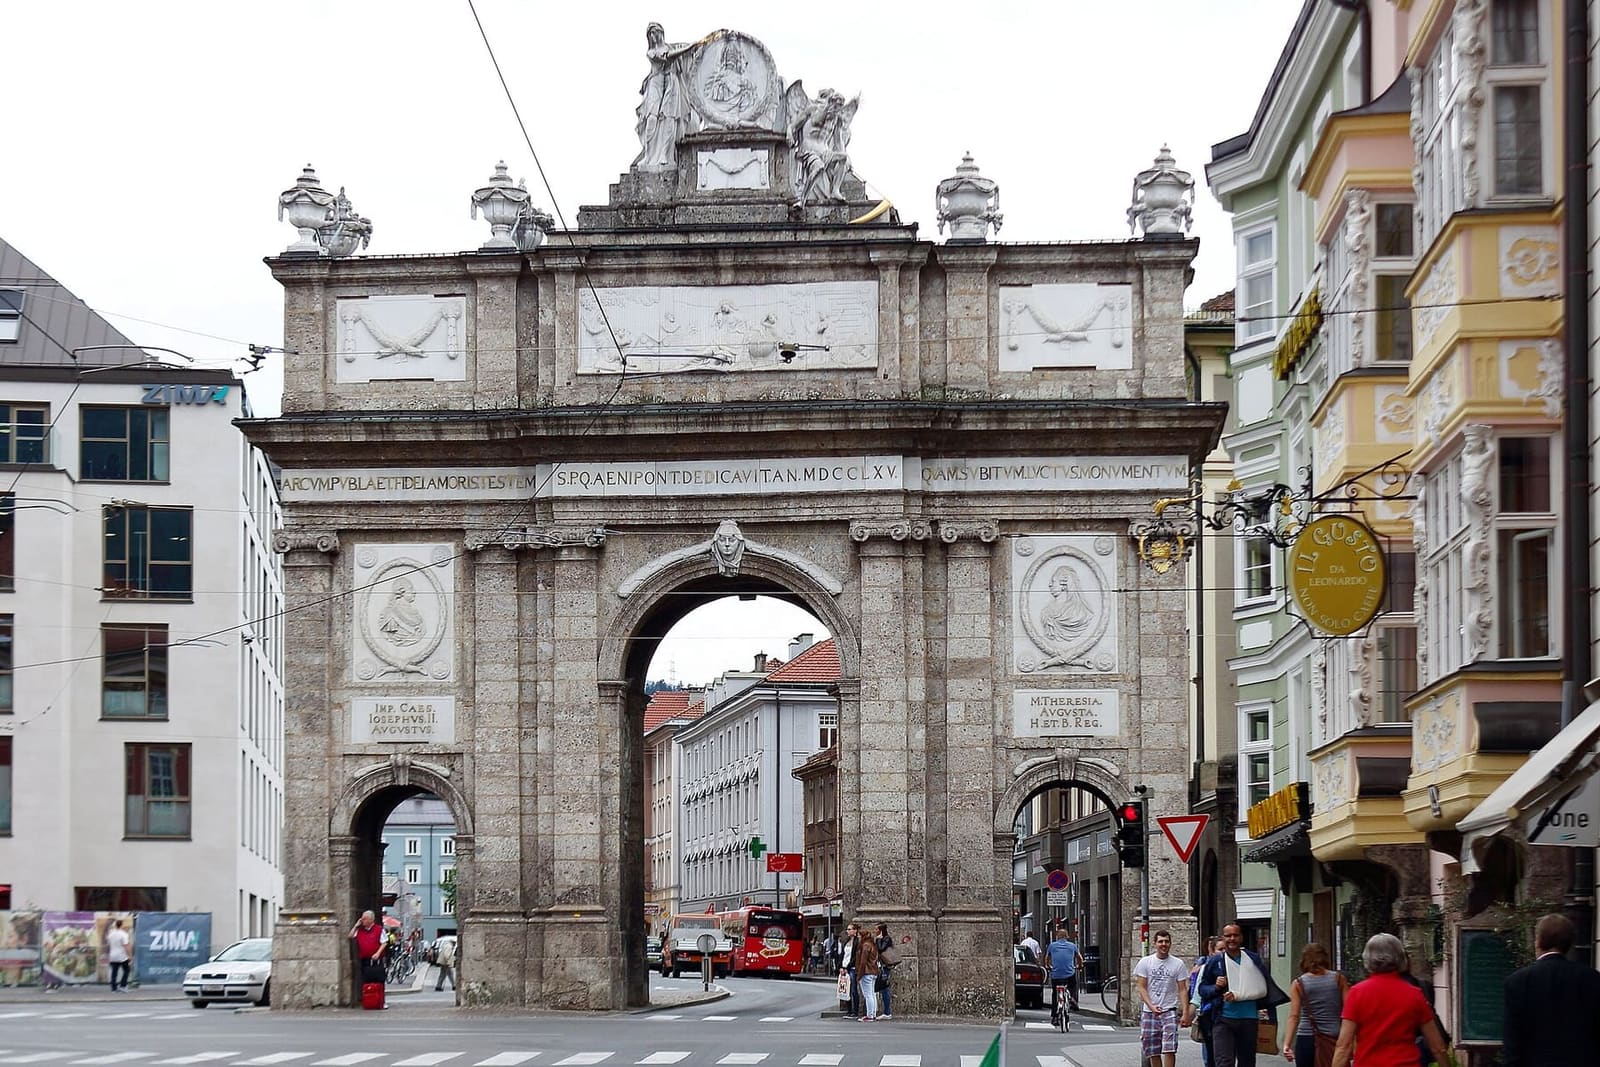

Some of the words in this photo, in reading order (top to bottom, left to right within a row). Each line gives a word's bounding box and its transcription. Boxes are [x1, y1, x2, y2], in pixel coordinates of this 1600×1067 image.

[142, 384, 229, 405] ZIMA
[1312, 522, 1377, 572] GUSTO
[1329, 565, 1345, 574] DA
[1308, 576, 1369, 587] LEONARDO
[1300, 587, 1319, 616] NON
[1320, 615, 1351, 629] SOLO
[149, 930, 200, 951] ZIMA
